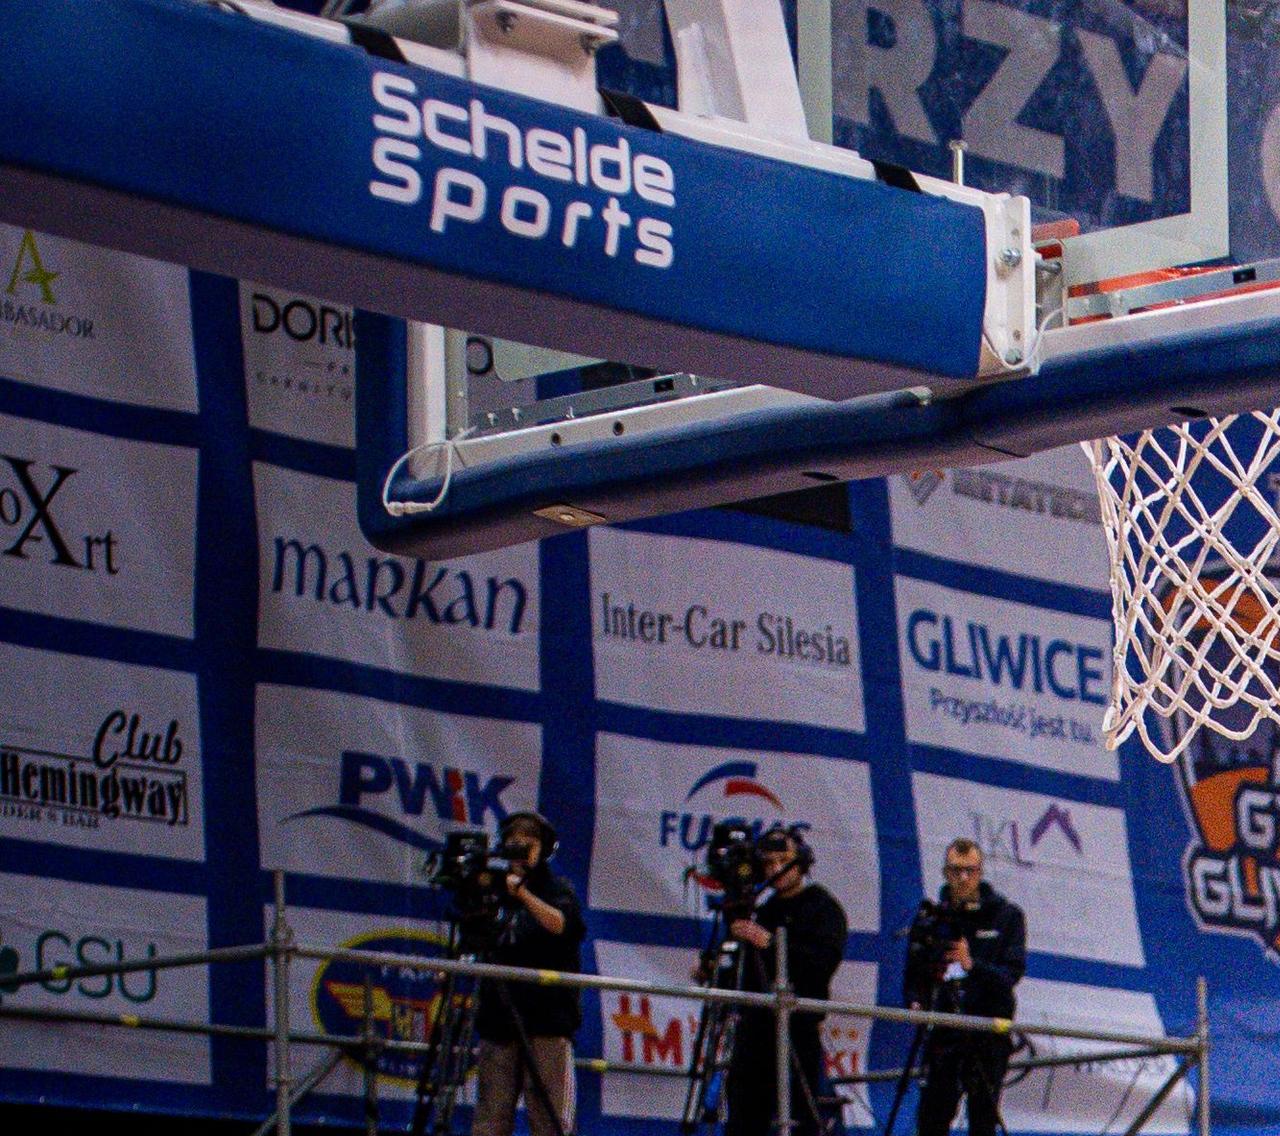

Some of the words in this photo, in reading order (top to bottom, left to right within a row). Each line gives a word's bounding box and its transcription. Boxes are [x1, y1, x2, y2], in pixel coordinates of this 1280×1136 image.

[371, 71, 676, 208] Schelde
[369, 138, 675, 269] Sports
[252, 293, 356, 350] DORI
[601, 593, 748, 652] Inter-Car
[756, 611, 852, 668] Silesia
[907, 607, 1108, 707] GLIWICE
[92, 709, 183, 769] Club
[0, 752, 184, 828] Hemingway
